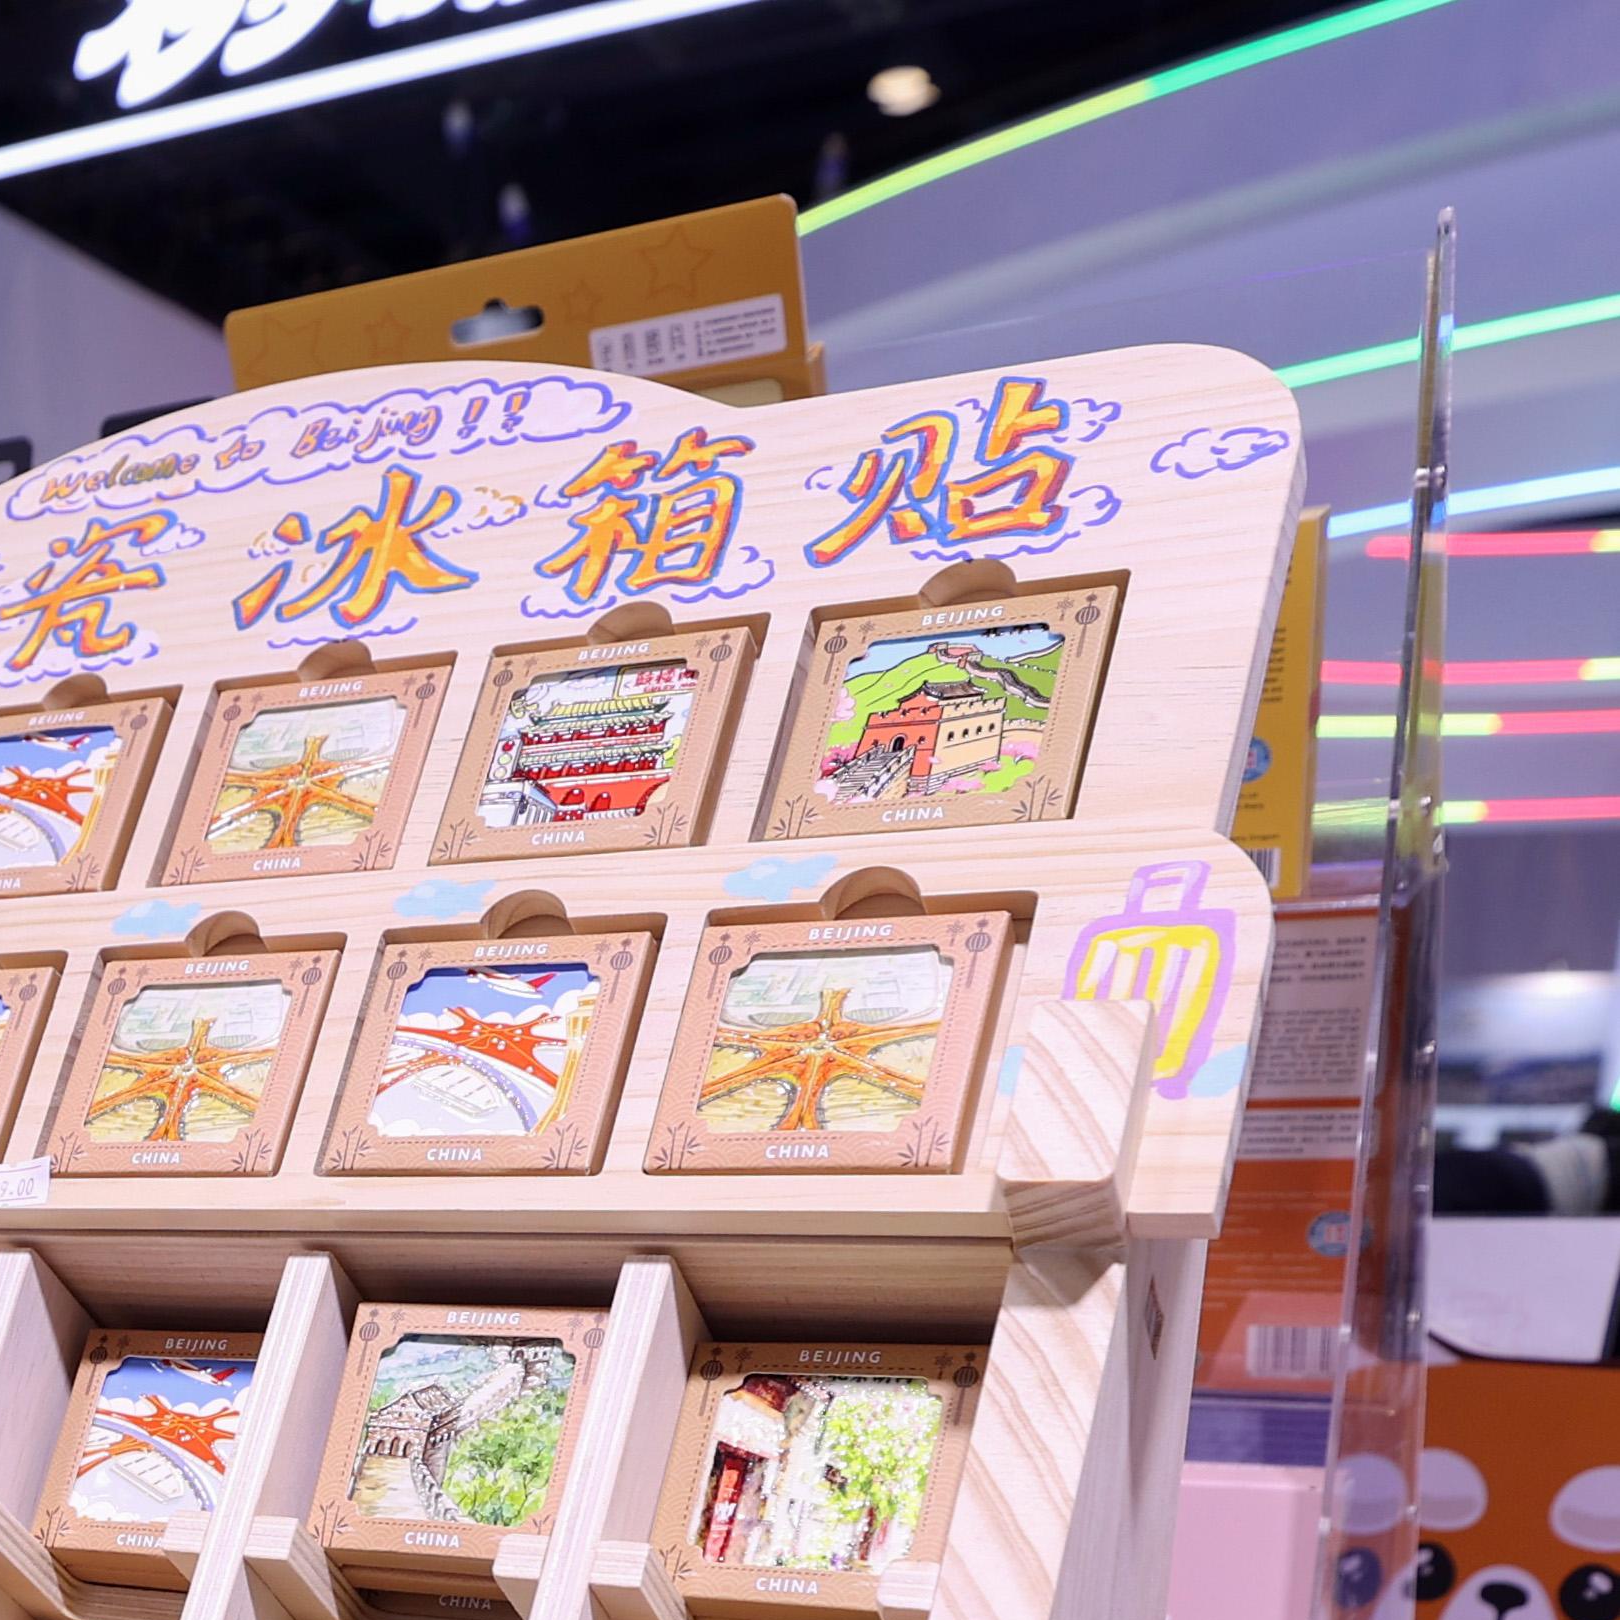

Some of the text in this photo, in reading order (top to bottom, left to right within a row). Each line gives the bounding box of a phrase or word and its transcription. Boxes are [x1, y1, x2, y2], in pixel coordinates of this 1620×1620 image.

[215, 434, 265, 471] to
[291, 402, 442, 458] Beijing
[920, 605, 1005, 627] BEIJING
[577, 641, 650, 662] BEIJING
[298, 680, 364, 698] BEIJING
[27, 711, 86, 727] BEIJING
[880, 805, 946, 823] CHINA
[529, 830, 587, 846] CHINA
[251, 855, 302, 871] CHINA
[807, 924, 894, 941] BEIJING
[473, 943, 549, 960] BEIJING
[184, 959, 250, 976] BEIJING
[131, 1151, 181, 1166] CHINA
[425, 1147, 484, 1163] CHINA
[764, 1143, 831, 1160] CHINA
[446, 1310, 521, 1326] BEIJING
[165, 1337, 228, 1351] BEIJING
[799, 1348, 883, 1364] BEIJING
[116, 1533, 163, 1548] CHINA
[403, 1531, 463, 1549] CHINA
[755, 1577, 819, 1595] CHINA
